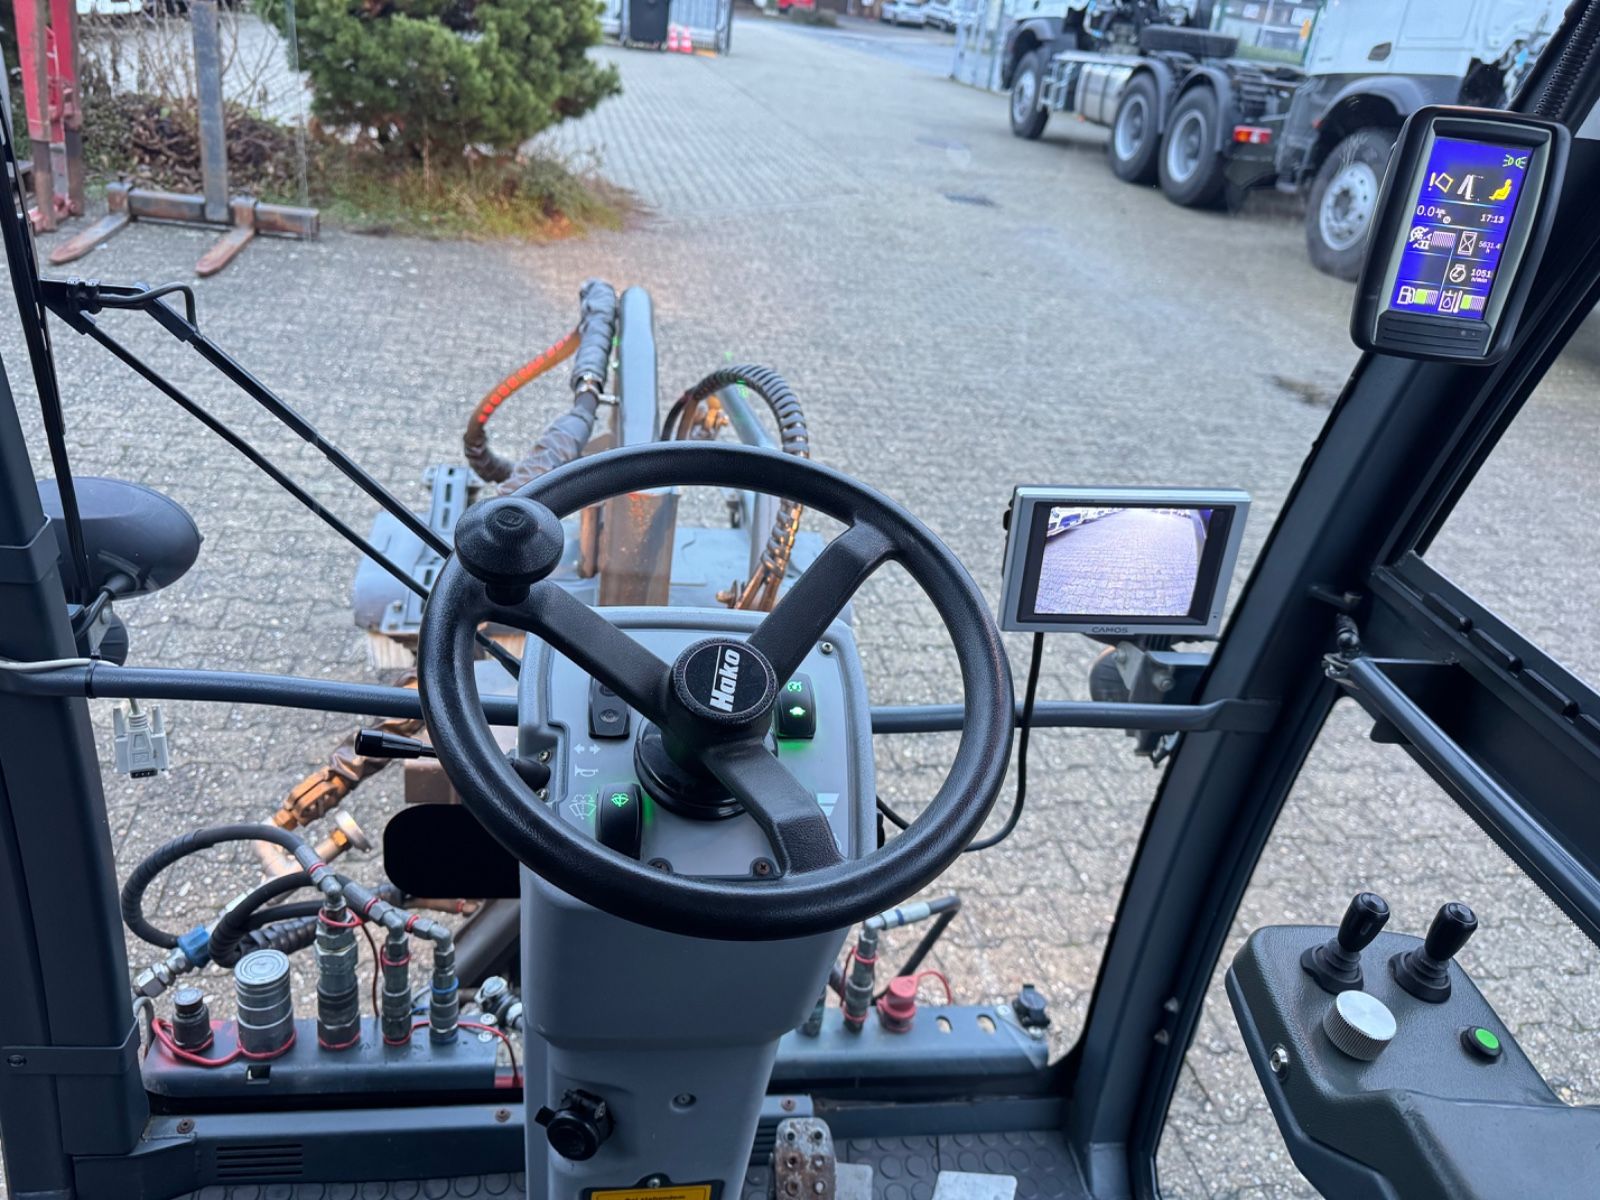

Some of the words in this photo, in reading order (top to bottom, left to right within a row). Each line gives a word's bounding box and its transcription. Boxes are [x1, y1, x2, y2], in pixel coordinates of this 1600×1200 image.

[1416, 205, 1435, 217] 0.0
[1480, 213, 1505, 224] 17:13
[1471, 268, 1492, 278] 1051
[709, 646, 741, 713] Hako
